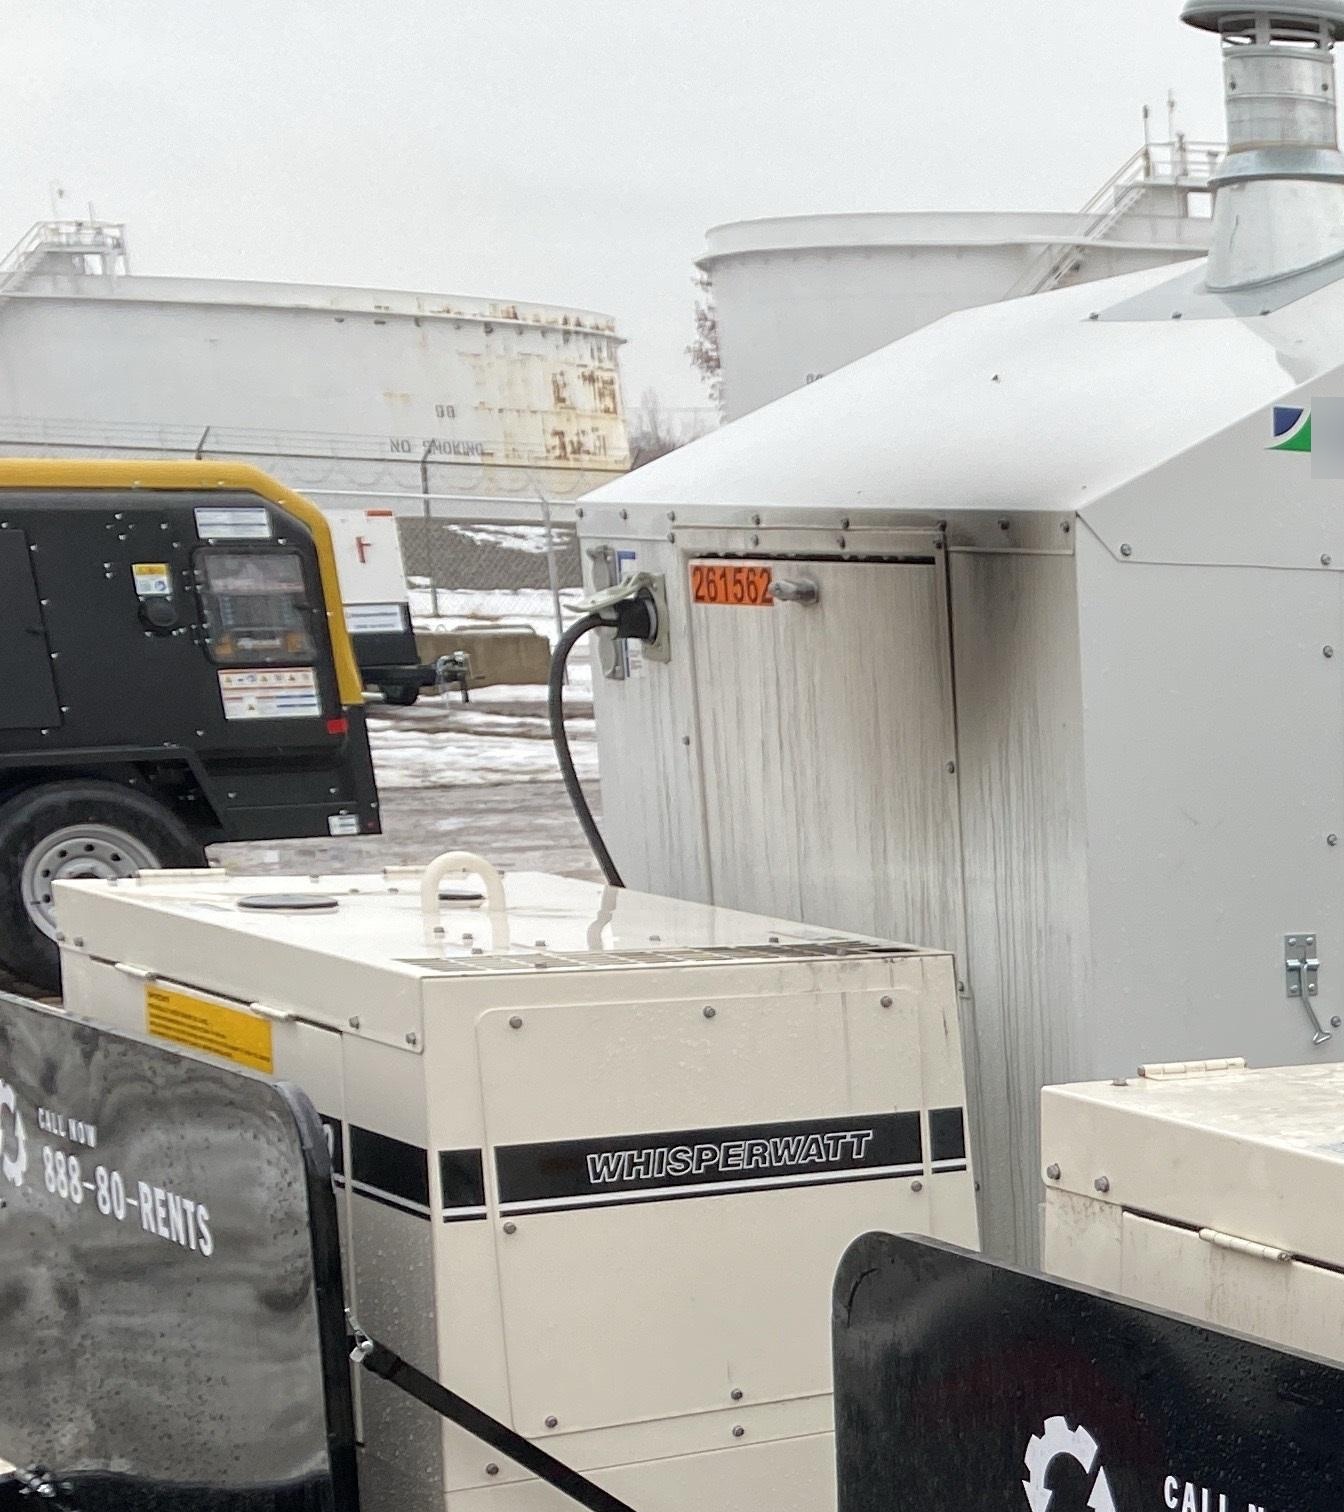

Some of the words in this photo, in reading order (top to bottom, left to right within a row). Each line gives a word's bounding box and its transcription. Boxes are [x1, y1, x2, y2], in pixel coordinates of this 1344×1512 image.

[692, 566, 774, 603] 261562
[38, 1106, 67, 1137] CALL
[67, 1118, 97, 1148] NOW
[586, 1130, 873, 1184] WHISPERWATT
[43, 1145, 214, 1257] 888-80-RENTS
